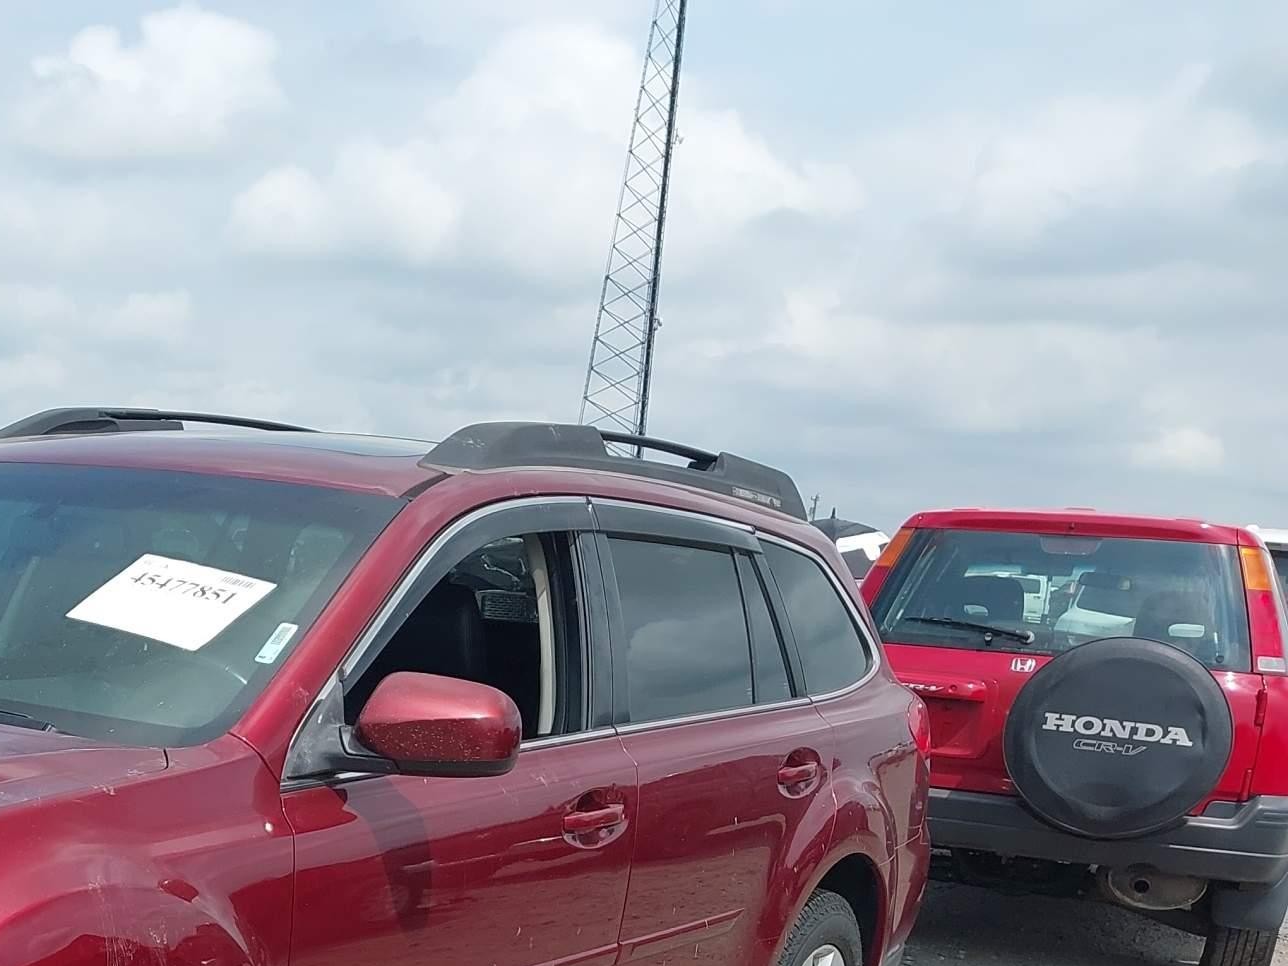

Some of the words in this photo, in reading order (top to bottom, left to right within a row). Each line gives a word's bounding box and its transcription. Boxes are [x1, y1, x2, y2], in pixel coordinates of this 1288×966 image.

[130, 572, 237, 604] 45477851
[1042, 712, 1193, 747] HONDA
[1073, 738, 1147, 756] CR-V
